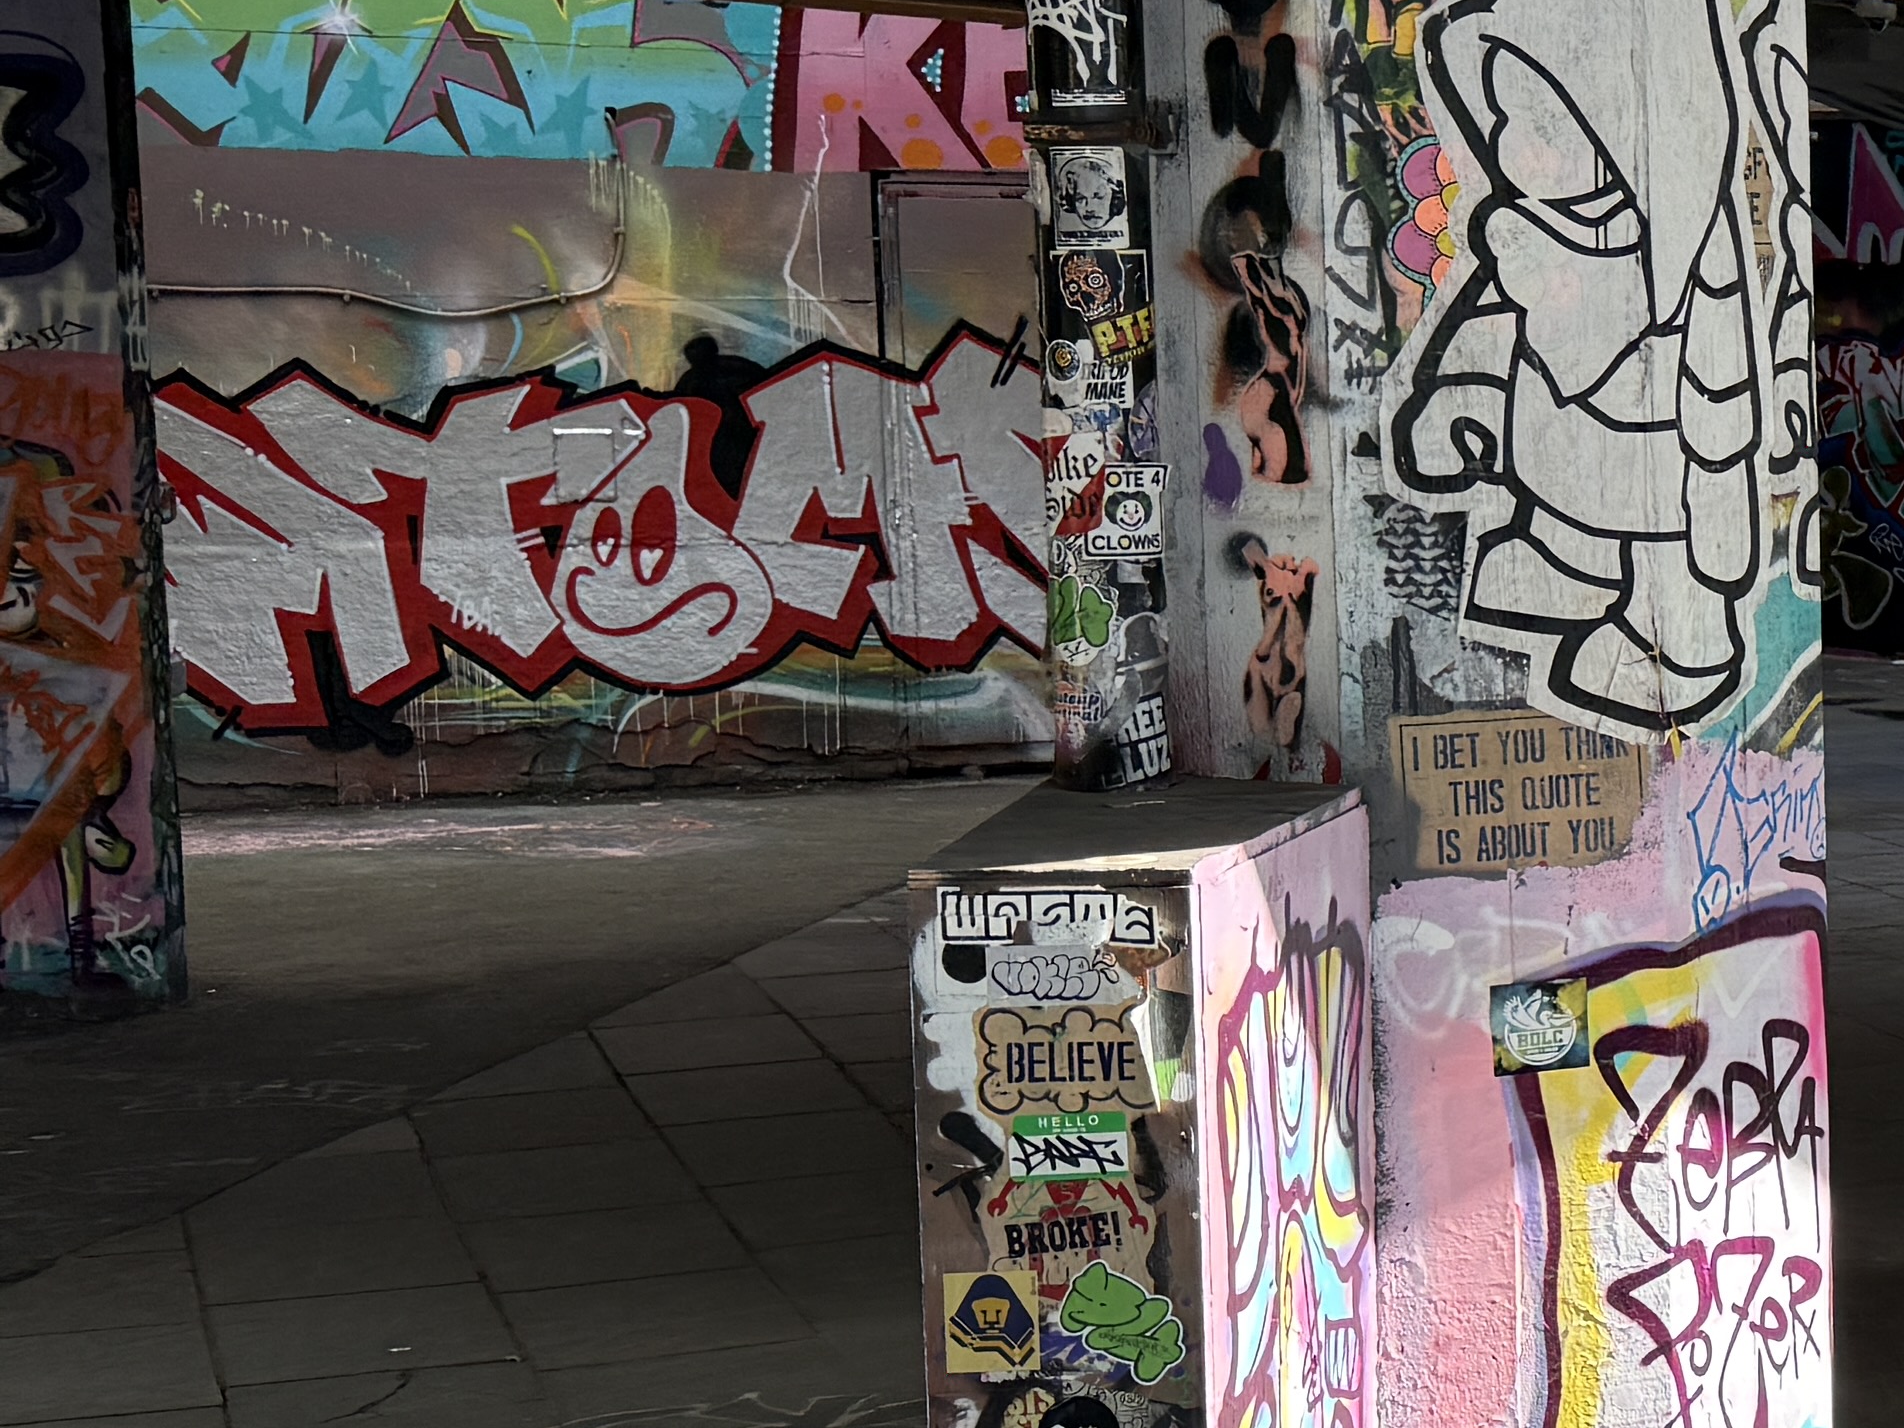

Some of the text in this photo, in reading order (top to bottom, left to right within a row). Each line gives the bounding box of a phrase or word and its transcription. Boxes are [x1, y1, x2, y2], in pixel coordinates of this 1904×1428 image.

[1106, 471, 1161, 488] OTE 4
[1410, 735, 1421, 772] I
[1433, 732, 1481, 769] BET
[1496, 729, 1546, 765] YOU
[1449, 773, 1601, 817] THIS QUOTE
[1436, 817, 1615, 865] IS ABOUT YOU
[1006, 1039, 1136, 1084] BELIEVE
[1038, 1114, 1099, 1129] HELLO
[1004, 1210, 1124, 1259] BROKE!
